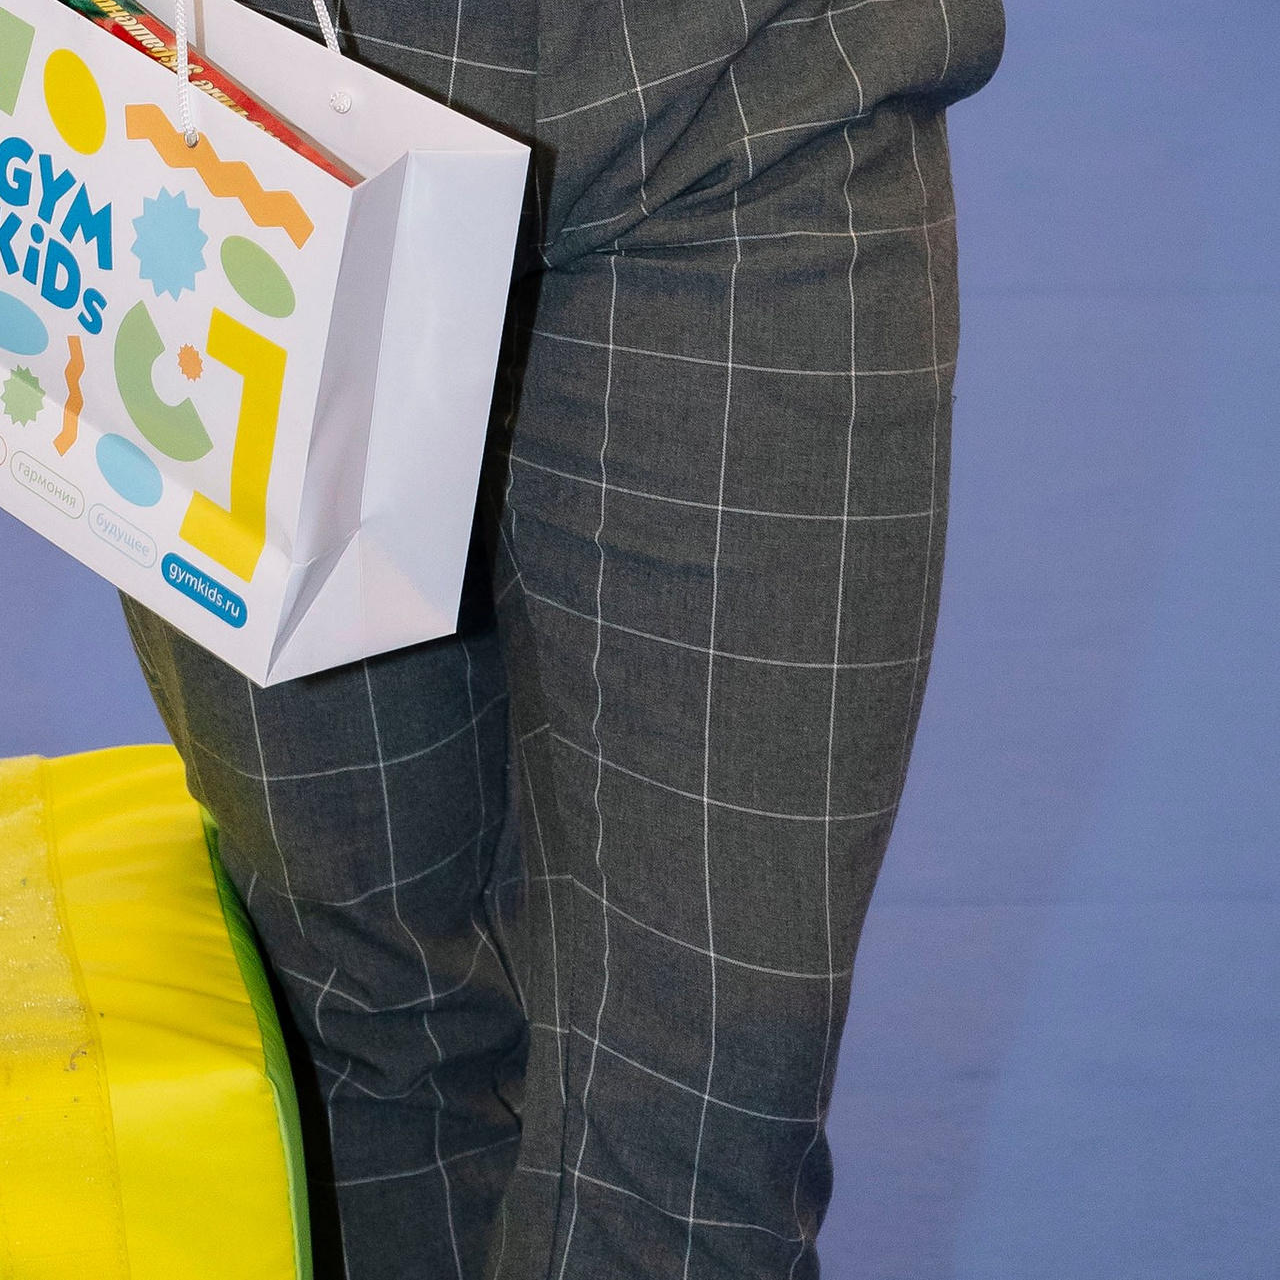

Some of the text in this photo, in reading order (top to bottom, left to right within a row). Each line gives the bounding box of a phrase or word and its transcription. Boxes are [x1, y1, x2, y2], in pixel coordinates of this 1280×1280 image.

[18, 460, 77, 509] гармония
[96, 512, 151, 557] будущее
[169, 561, 241, 619] gymkids.ru
